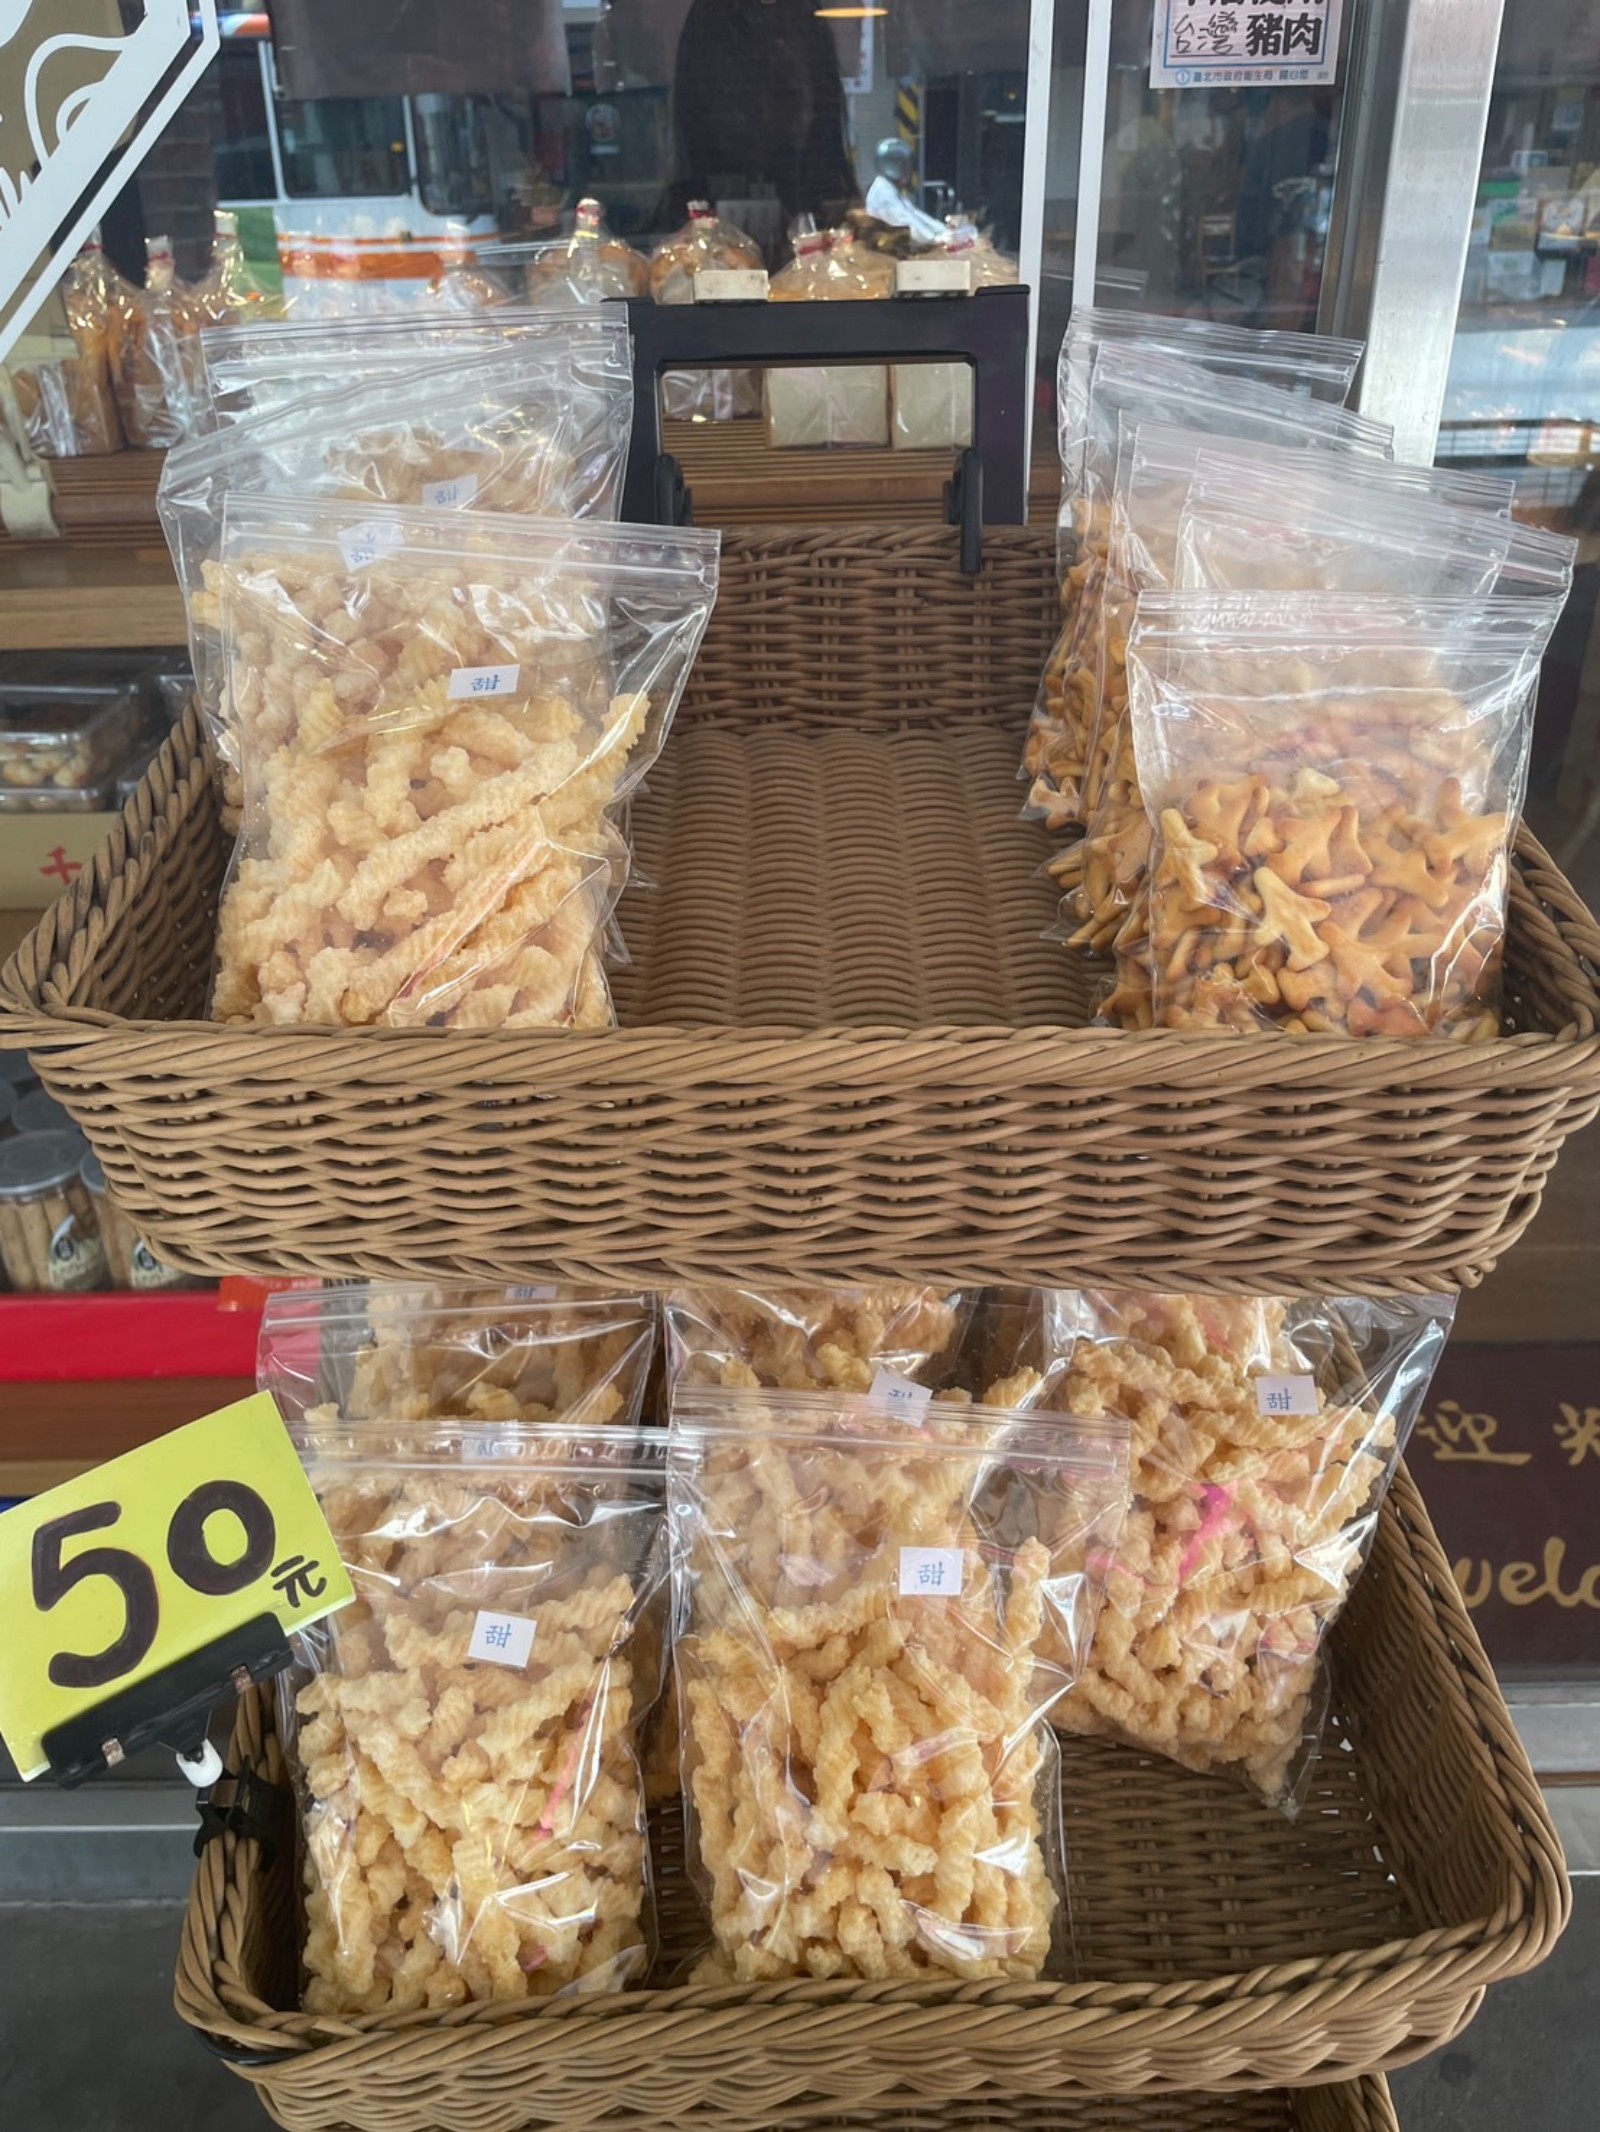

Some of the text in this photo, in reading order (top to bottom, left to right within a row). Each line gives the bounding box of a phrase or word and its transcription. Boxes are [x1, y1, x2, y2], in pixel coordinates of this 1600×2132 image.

[1265, 1387, 1292, 1410] 甜
[917, 1561, 945, 1586] 甜
[485, 1623, 512, 1648] 甜
